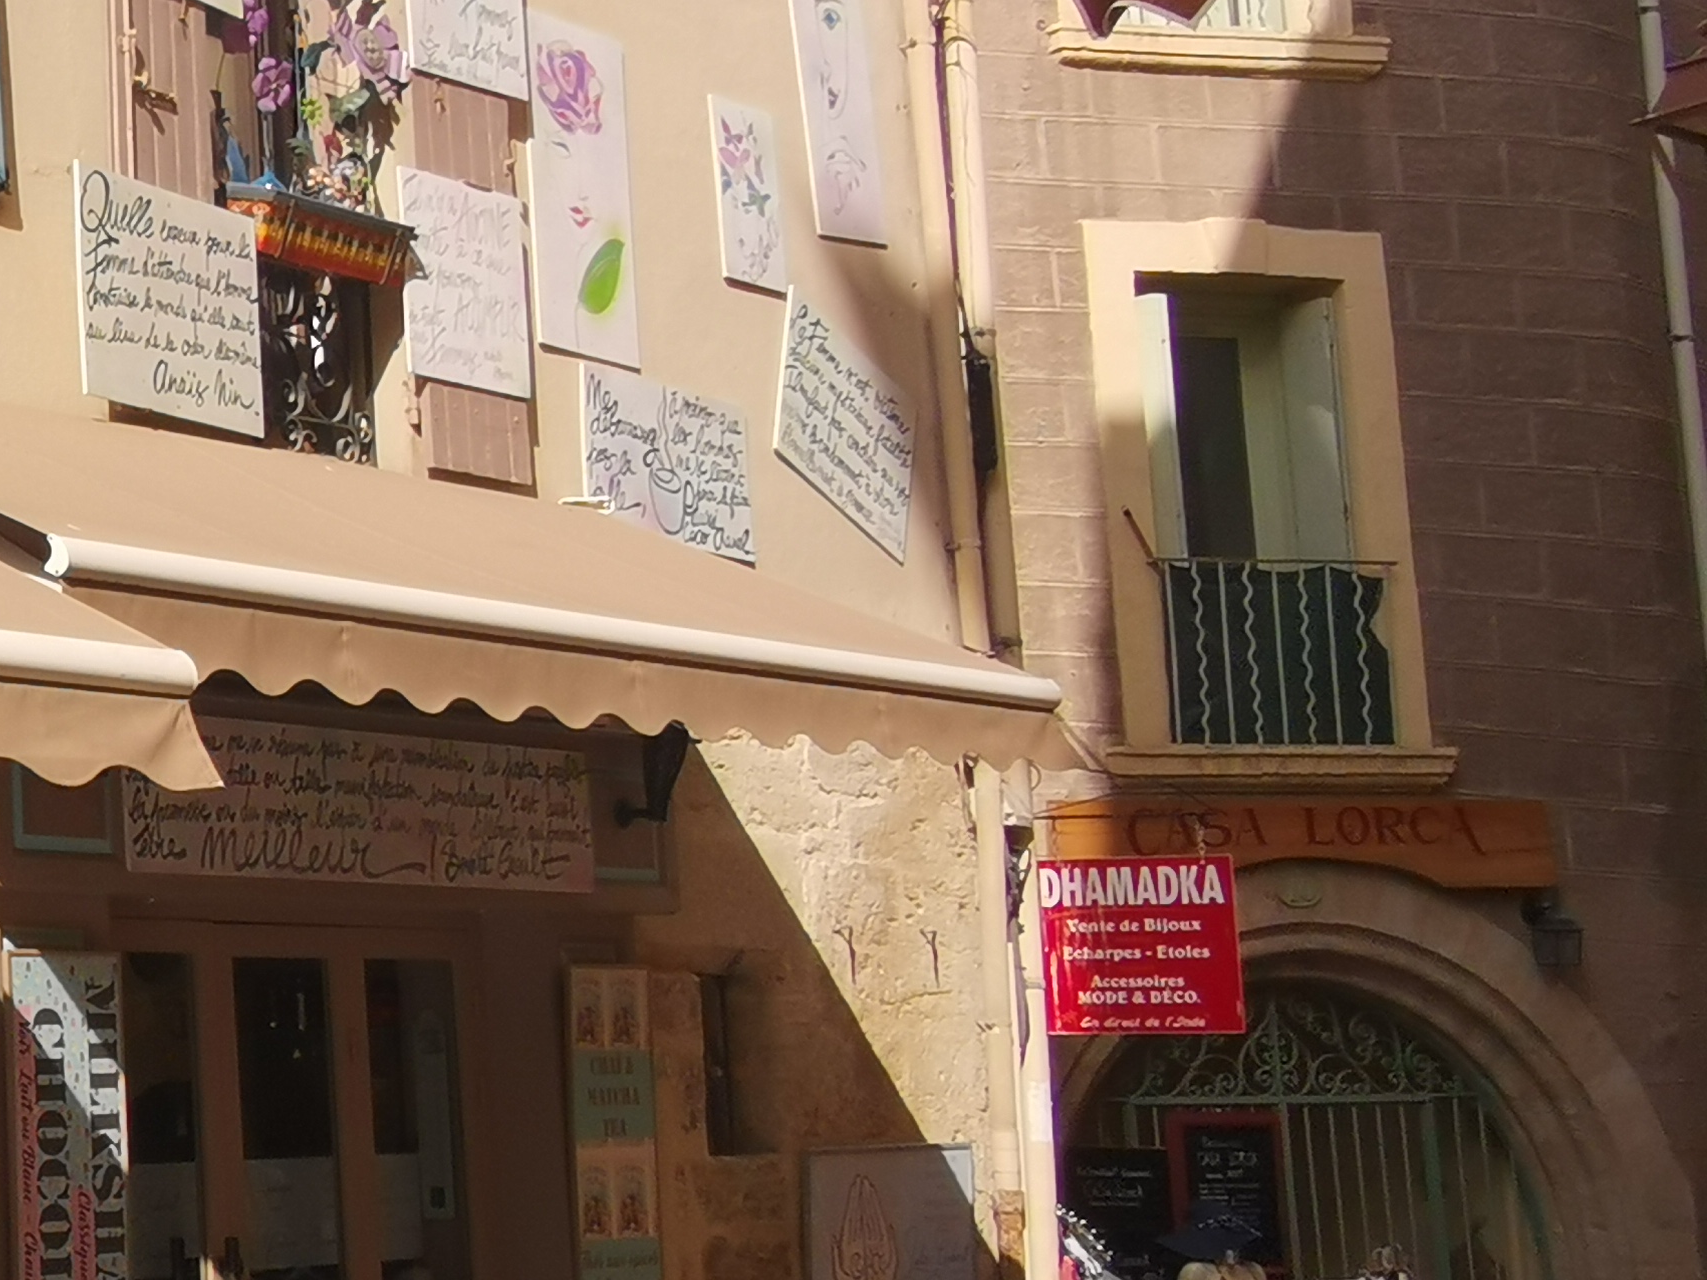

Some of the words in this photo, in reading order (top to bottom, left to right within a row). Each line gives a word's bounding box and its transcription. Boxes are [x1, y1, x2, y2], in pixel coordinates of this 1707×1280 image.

[80, 169, 155, 239] Quelle
[1125, 807, 1267, 856] CASA
[1304, 805, 1488, 856] LORCA
[1039, 864, 1226, 908] DHAMADKA
[1066, 918, 1117, 933] Vente
[1119, 919, 1140, 933] de
[1143, 918, 1202, 935] Bijoux
[1062, 945, 1143, 963] Echarpes
[1156, 945, 1211, 960] Etoles
[1089, 974, 1185, 989] Accessoires
[1078, 990, 1129, 1005] MODE
[1131, 990, 1146, 1005] &
